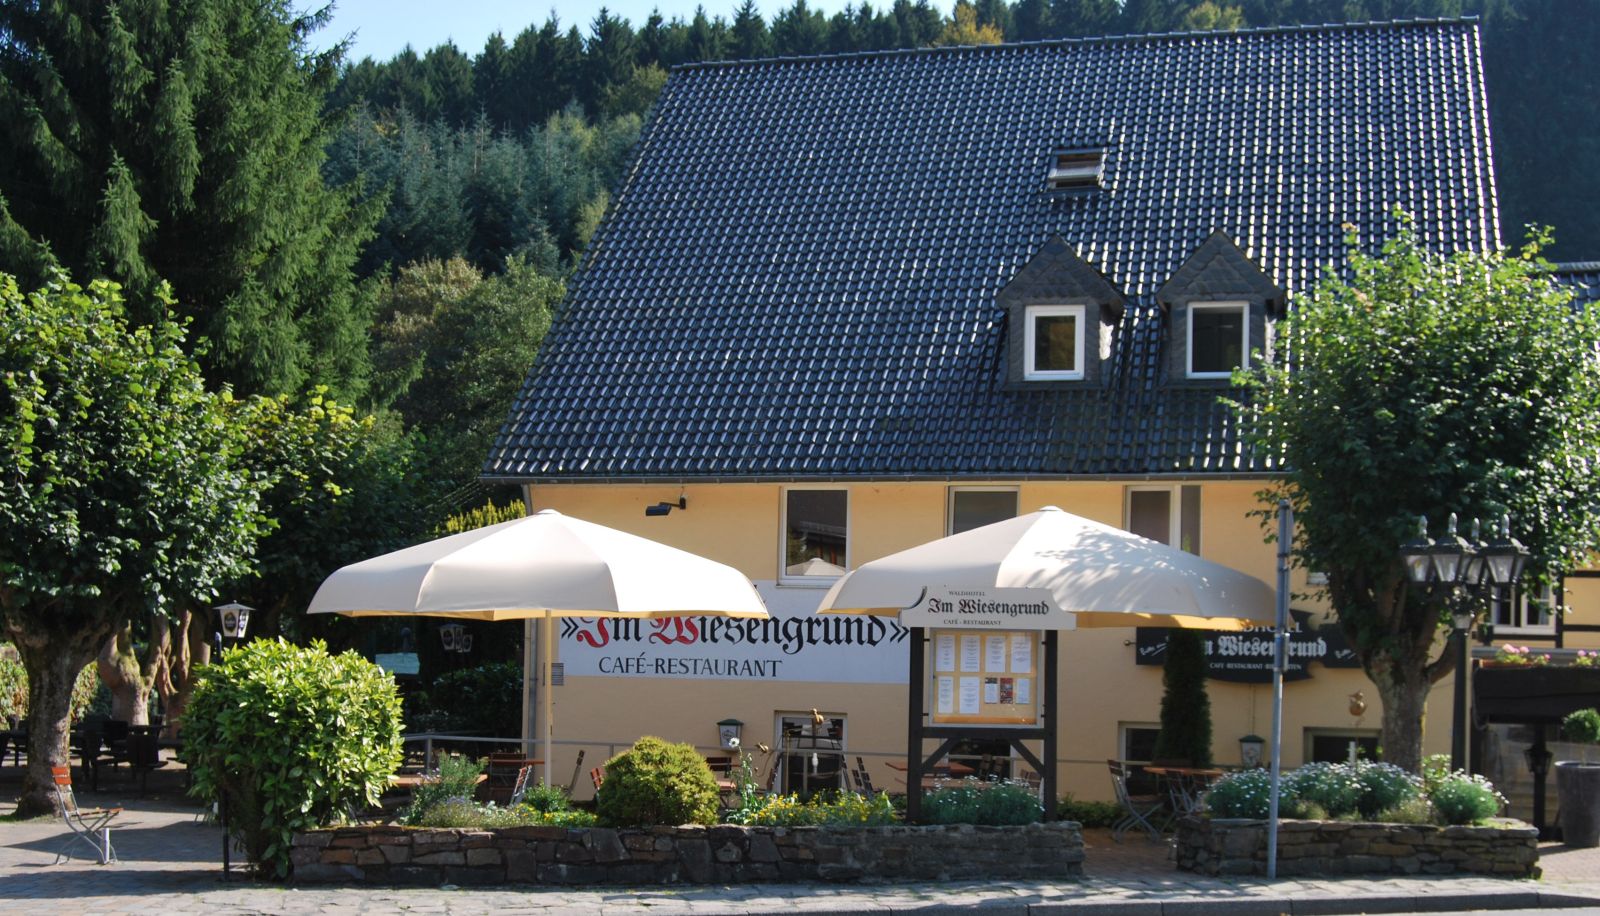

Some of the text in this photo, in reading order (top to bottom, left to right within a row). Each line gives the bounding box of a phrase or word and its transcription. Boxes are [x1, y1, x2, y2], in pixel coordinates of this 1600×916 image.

[928, 598, 1049, 617] Im Wiesengrund
[1218, 635, 1327, 657] Wiesenrund
[598, 652, 783, 677] CAFÉ-RESTAURANT
